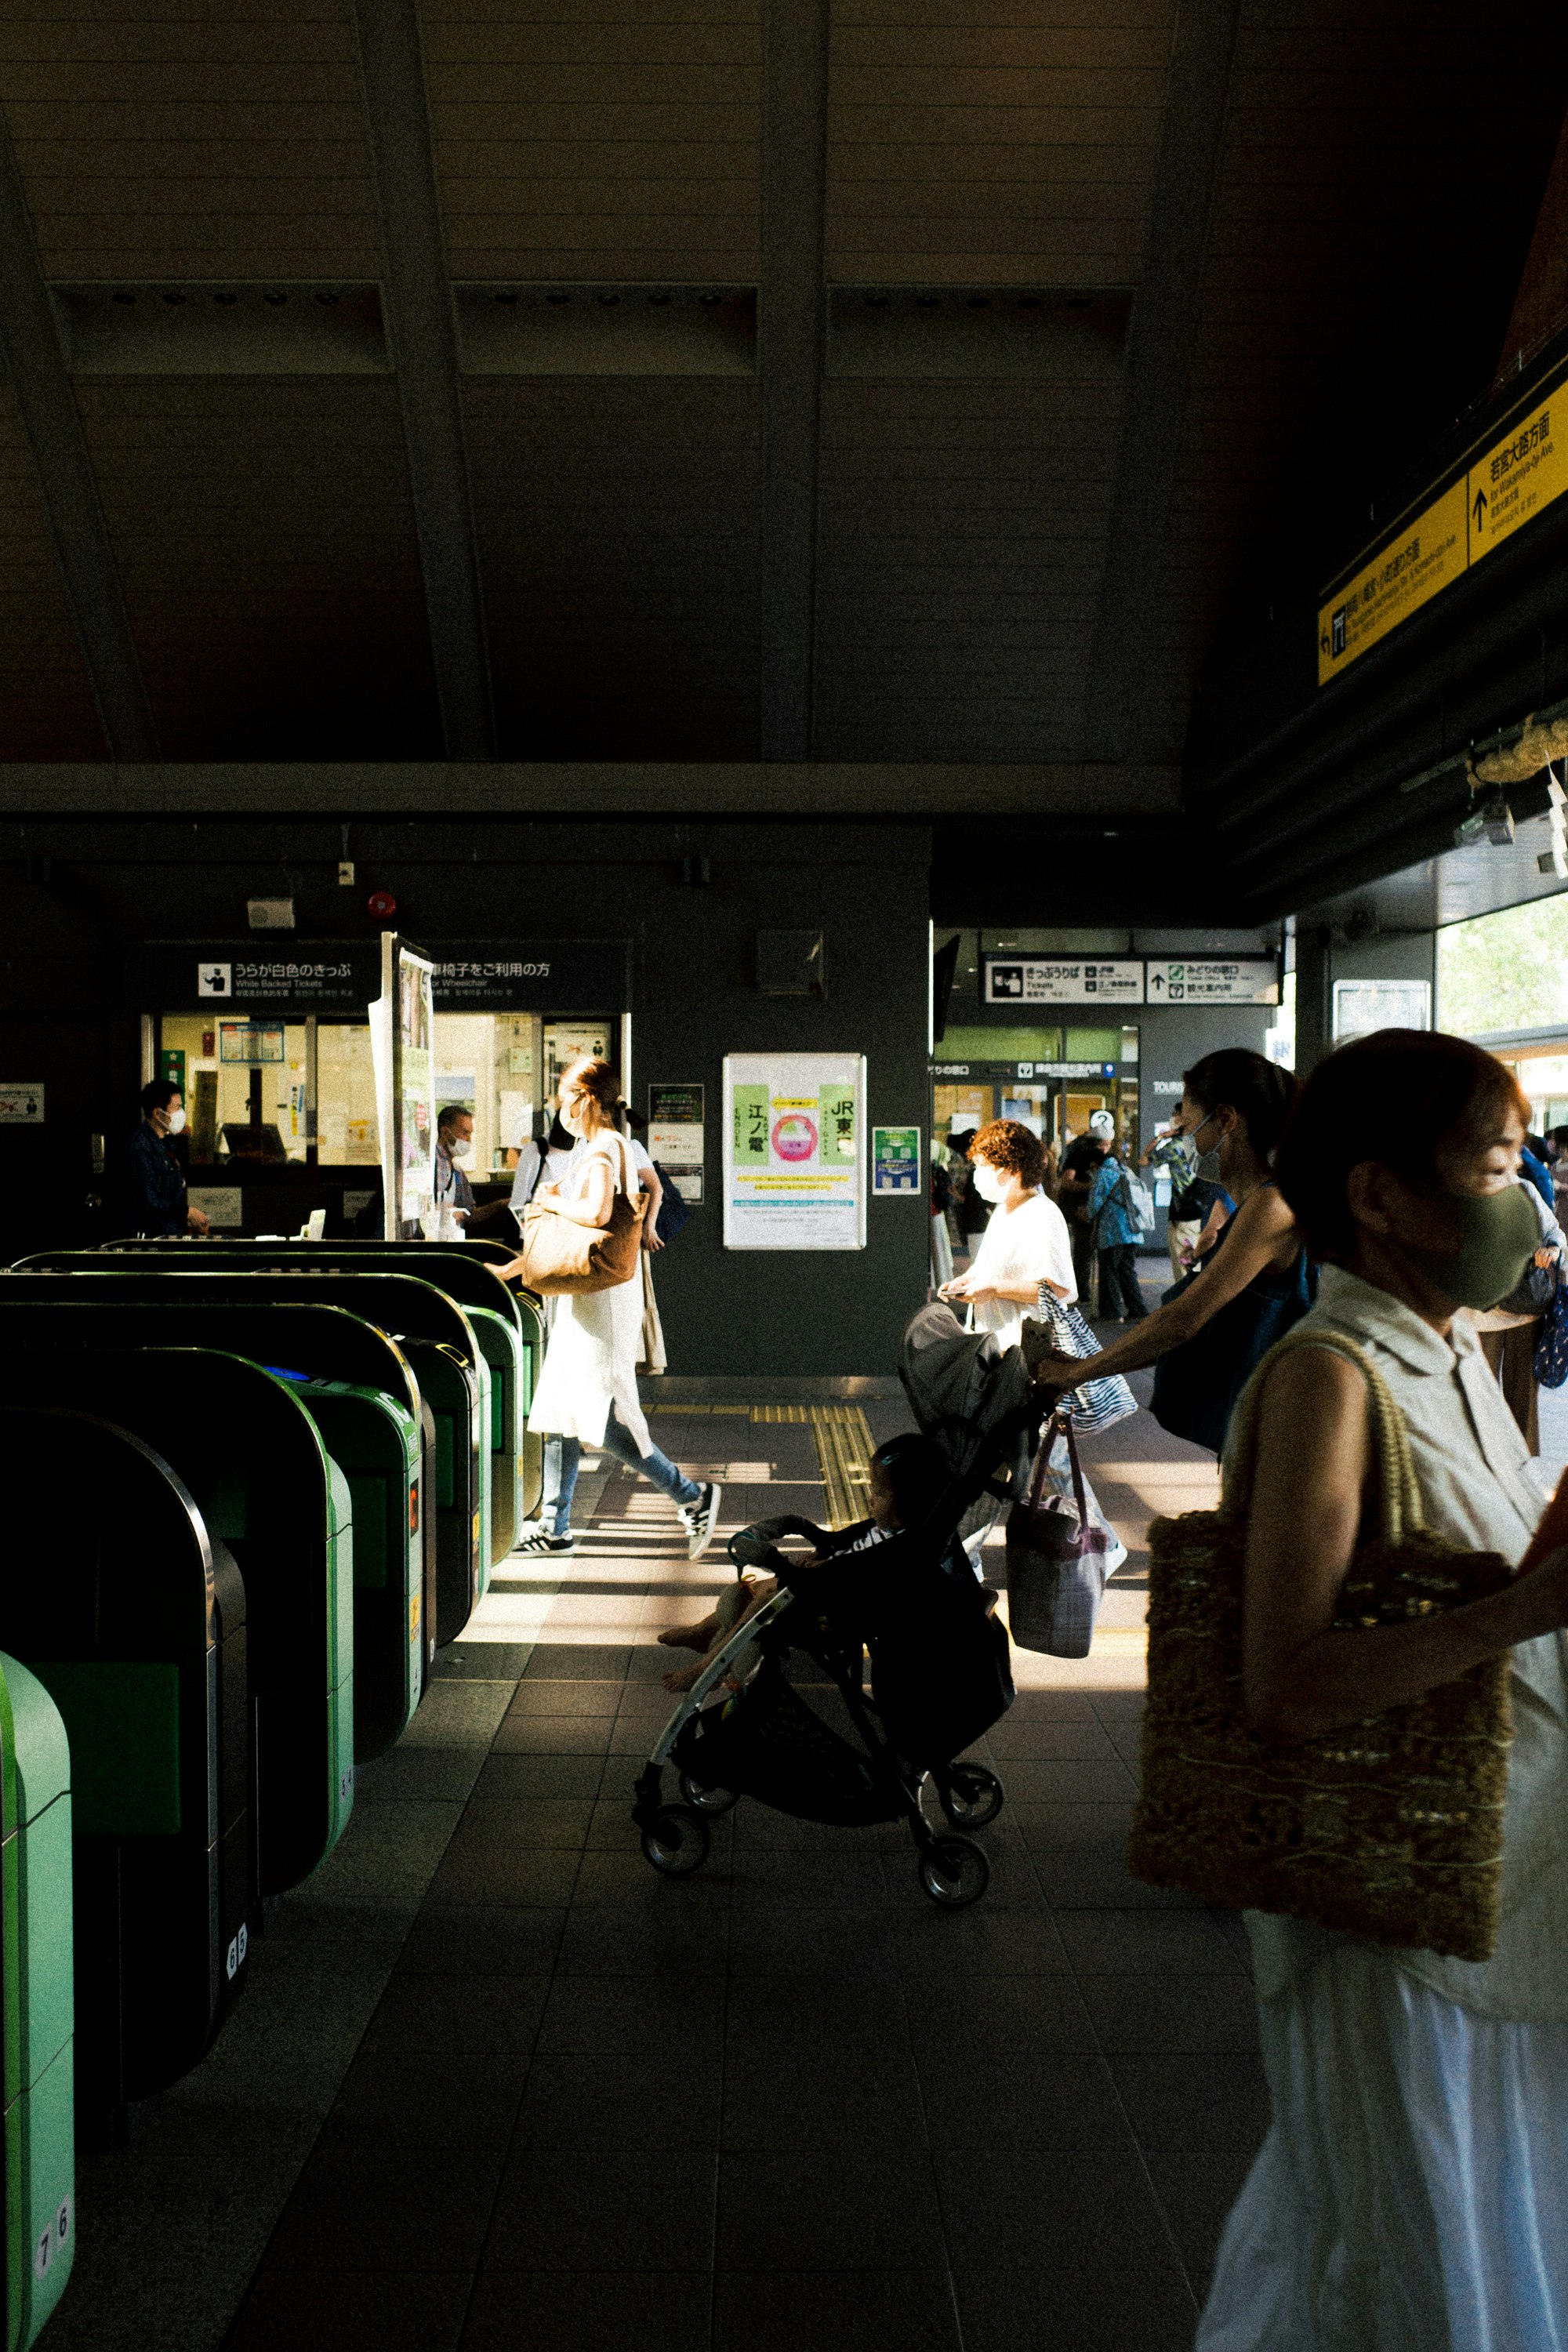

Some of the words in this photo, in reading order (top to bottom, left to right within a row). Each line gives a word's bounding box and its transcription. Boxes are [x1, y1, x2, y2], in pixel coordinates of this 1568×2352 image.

[1490, 410, 1550, 483] 若宮大路方面
[236, 964, 351, 978] うらが白色のきっぷ
[1026, 966, 1080, 980] きっぷうりば
[1187, 965, 1239, 975] みどりの窓口
[236, 979, 260, 988] White
[261, 979, 292, 988] Backed
[295, 979, 323, 988] Tickets
[748, 1104, 764, 1152] 江ノ電
[240, 1932, 245, 1952] 5
[230, 1947, 235, 1969] 6
[59, 2206, 67, 2237] 6
[41, 2234, 49, 2267] 7
